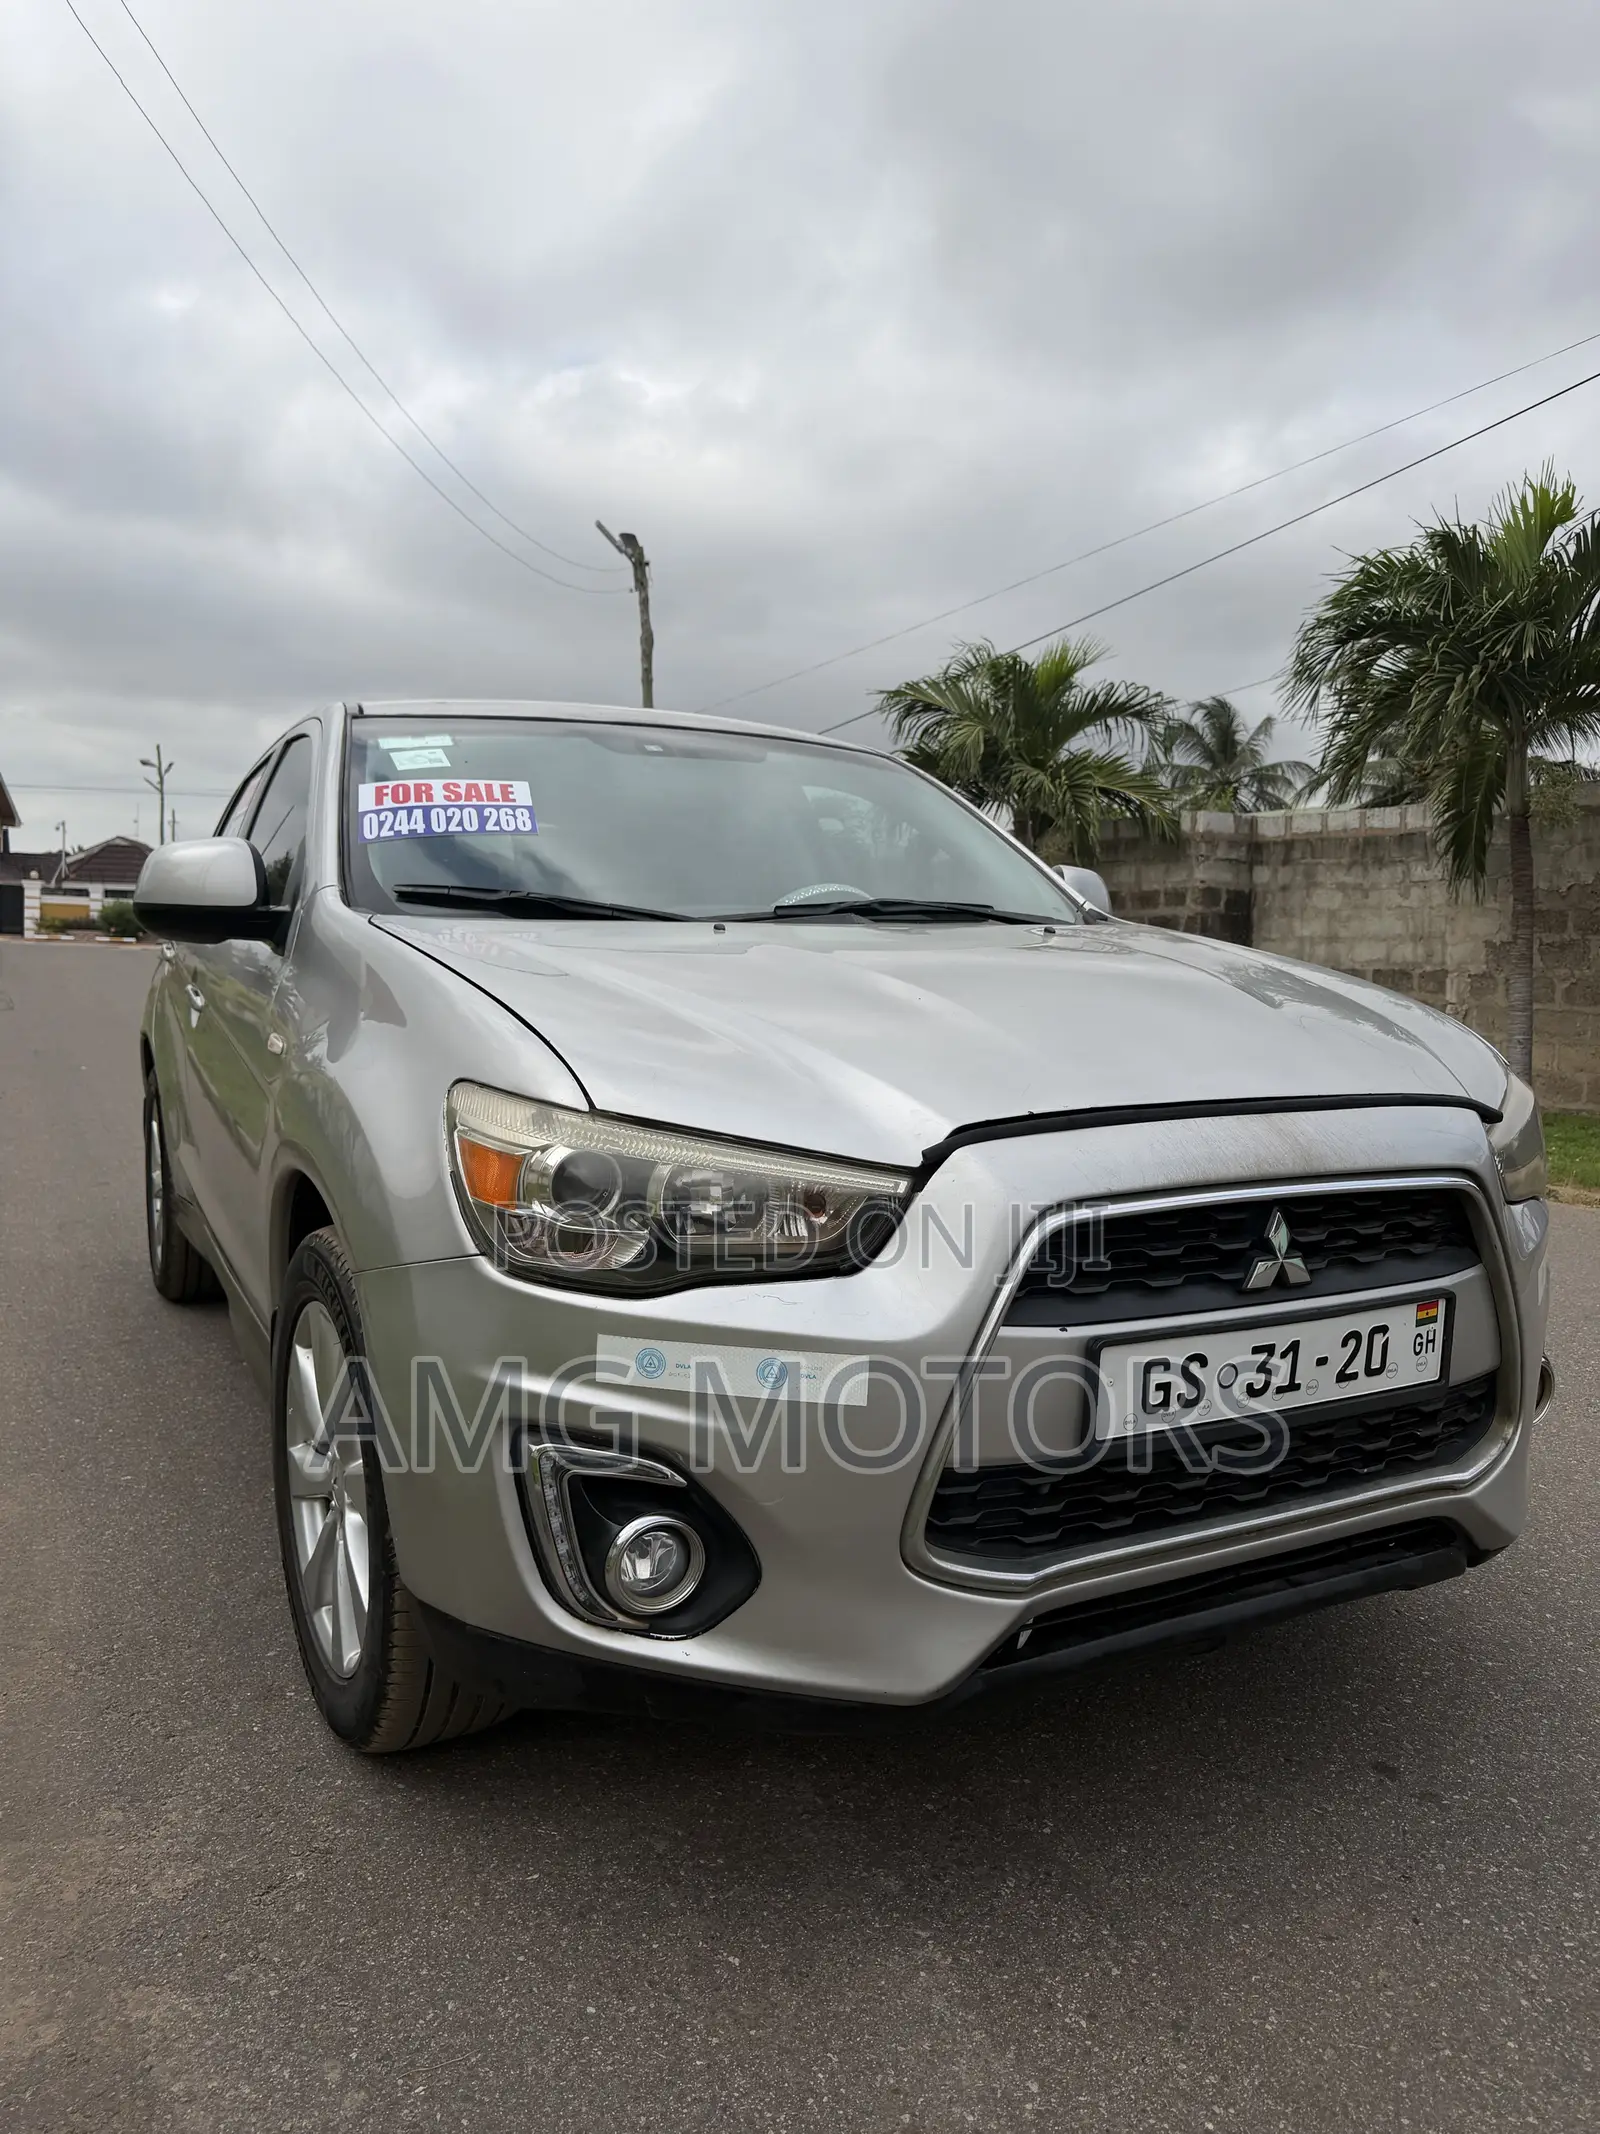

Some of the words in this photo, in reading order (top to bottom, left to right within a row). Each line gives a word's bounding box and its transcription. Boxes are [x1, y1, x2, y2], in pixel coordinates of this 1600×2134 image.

[374, 782, 434, 807] FOR
[442, 782, 517, 804] SALE
[362, 808, 426, 840] 0244
[430, 807, 479, 833] 020
[483, 807, 533, 833] 268
[1413, 1328, 1437, 1357] GH
[1141, 1352, 1209, 1415] GS
